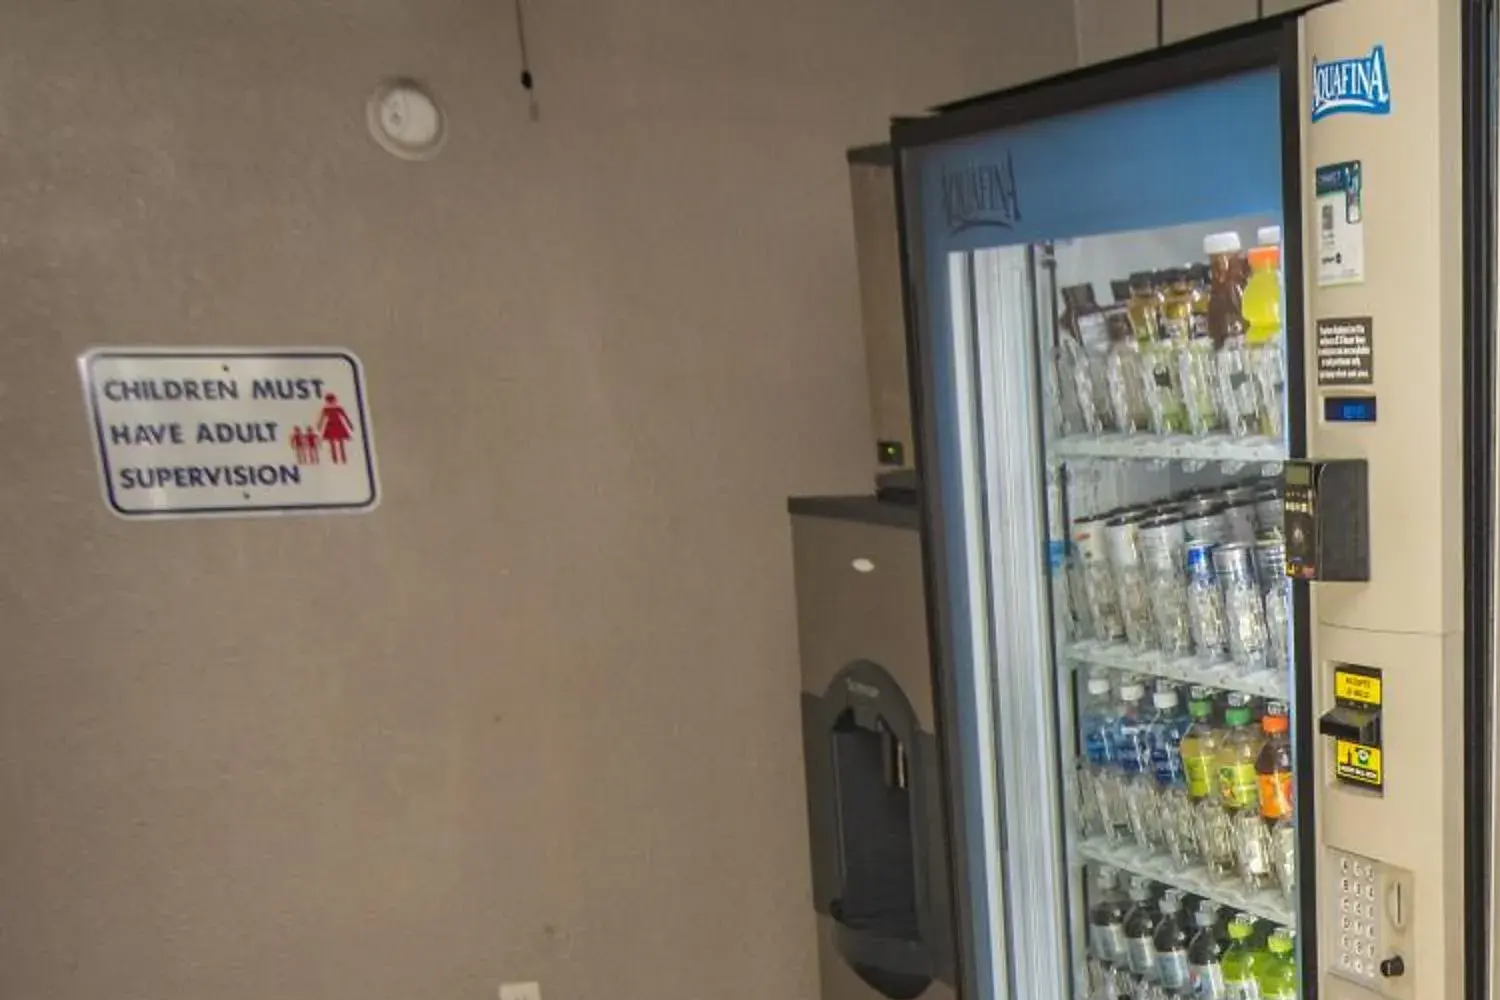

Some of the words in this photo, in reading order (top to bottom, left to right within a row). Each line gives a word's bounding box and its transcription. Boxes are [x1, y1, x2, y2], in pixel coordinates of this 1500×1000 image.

[1312, 50, 1389, 108] AQUAFINA
[103, 378, 239, 402] CHILDREN
[251, 378, 325, 401] MUST
[110, 424, 184, 446] HAVE
[196, 422, 280, 445] ADULT
[119, 464, 301, 490] SUPERVISION
